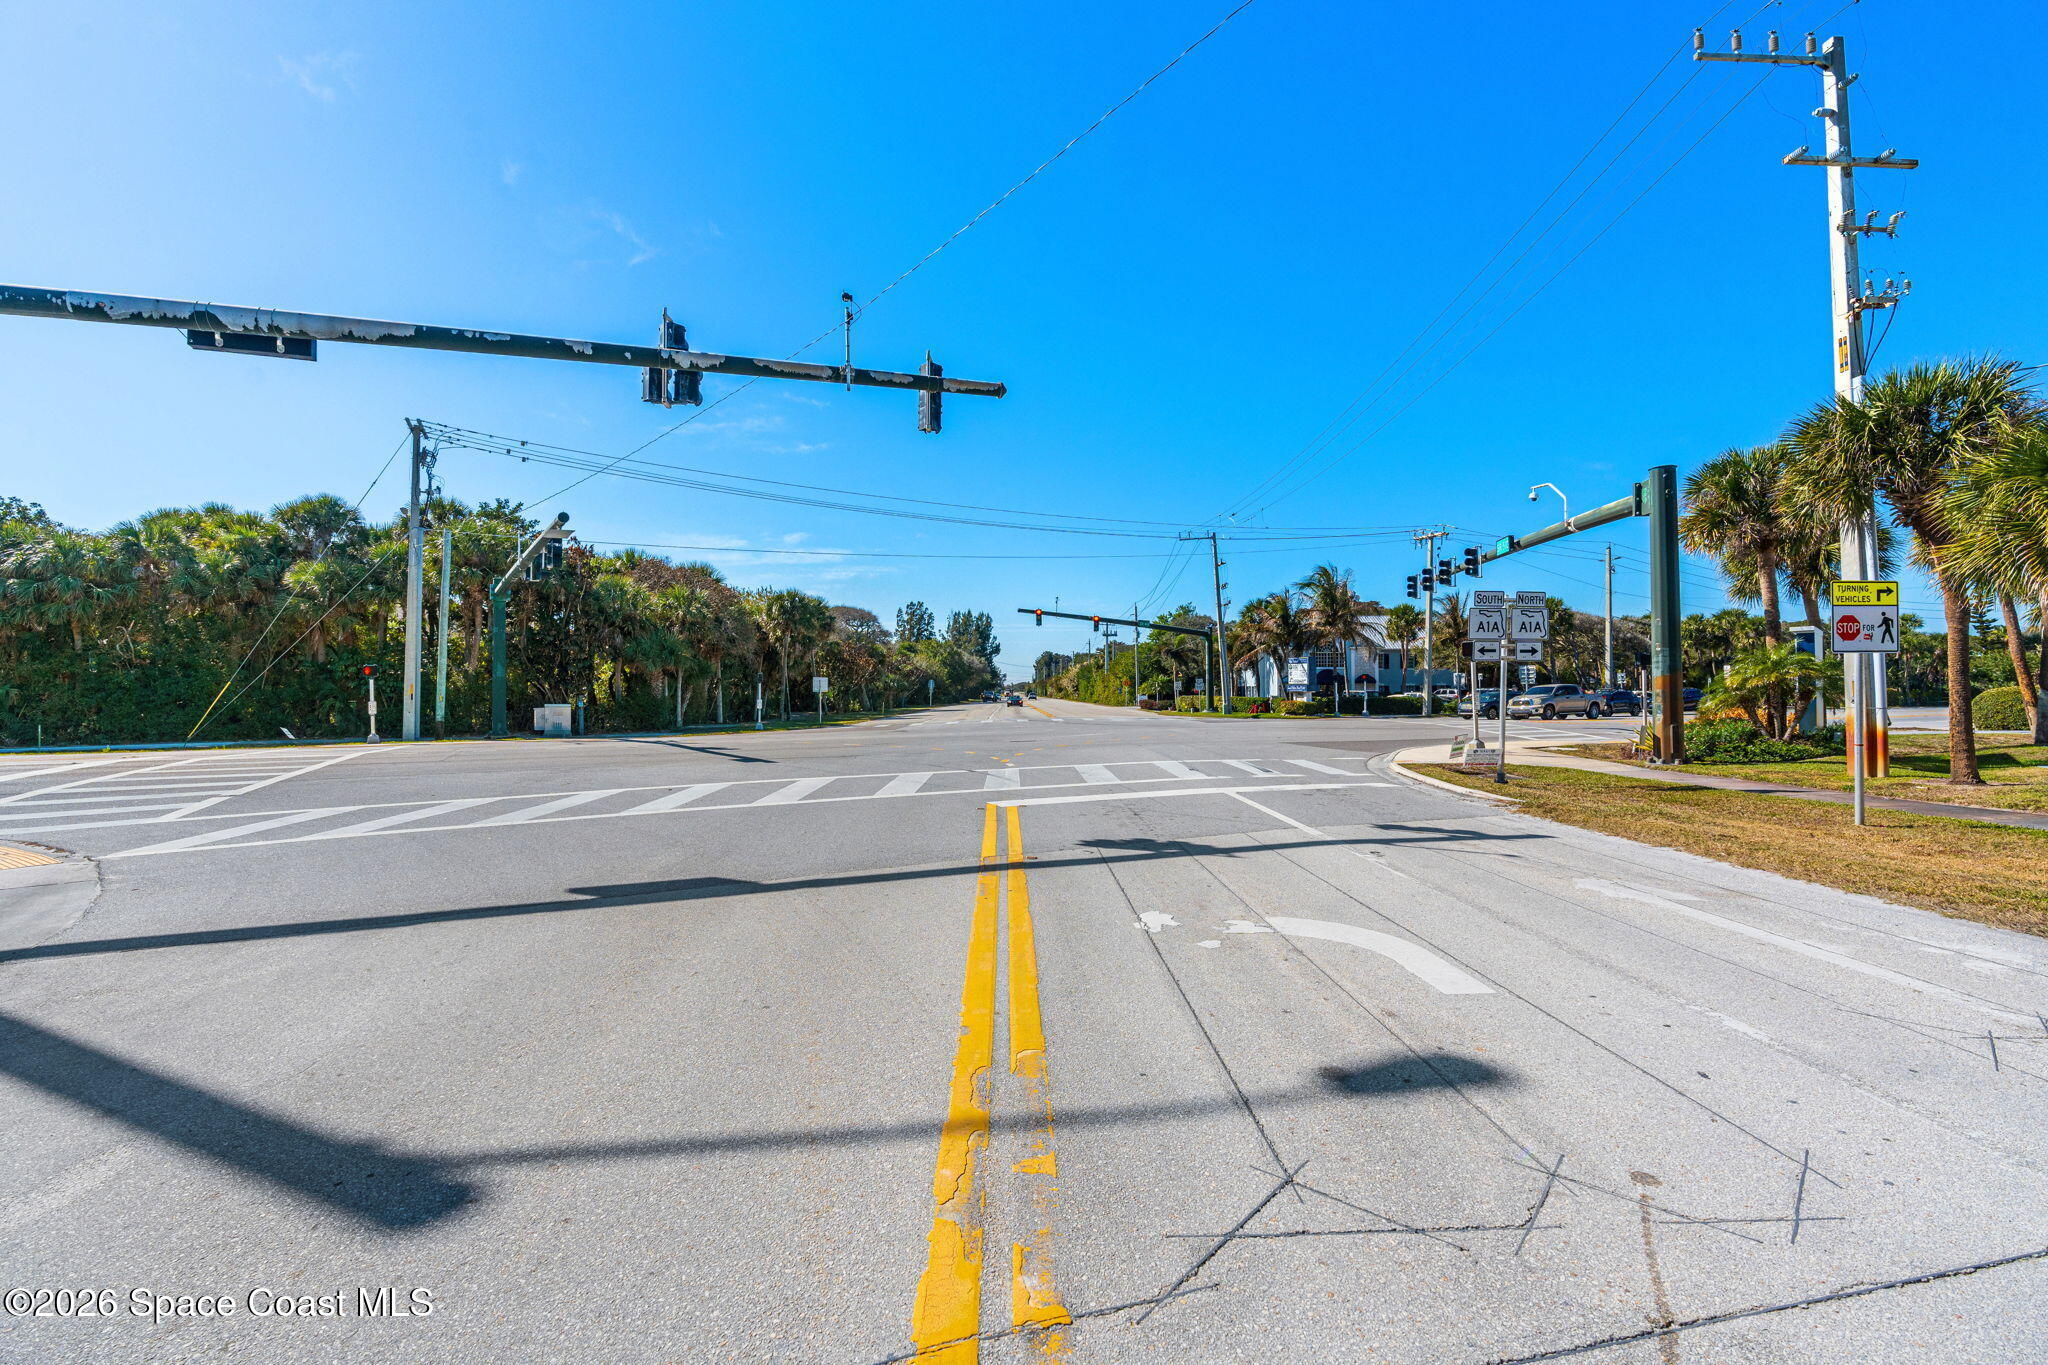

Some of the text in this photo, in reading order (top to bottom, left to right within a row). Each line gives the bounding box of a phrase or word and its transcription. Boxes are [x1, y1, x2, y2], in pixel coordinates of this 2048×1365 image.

[1476, 593, 1503, 604] SOUTH
[1518, 594, 1544, 605] NORTH
[1835, 595, 1871, 603] VEHICLES
[1476, 621, 1500, 633] A1A
[1519, 621, 1542, 633] A1A
[1837, 622, 1860, 634] STOP
